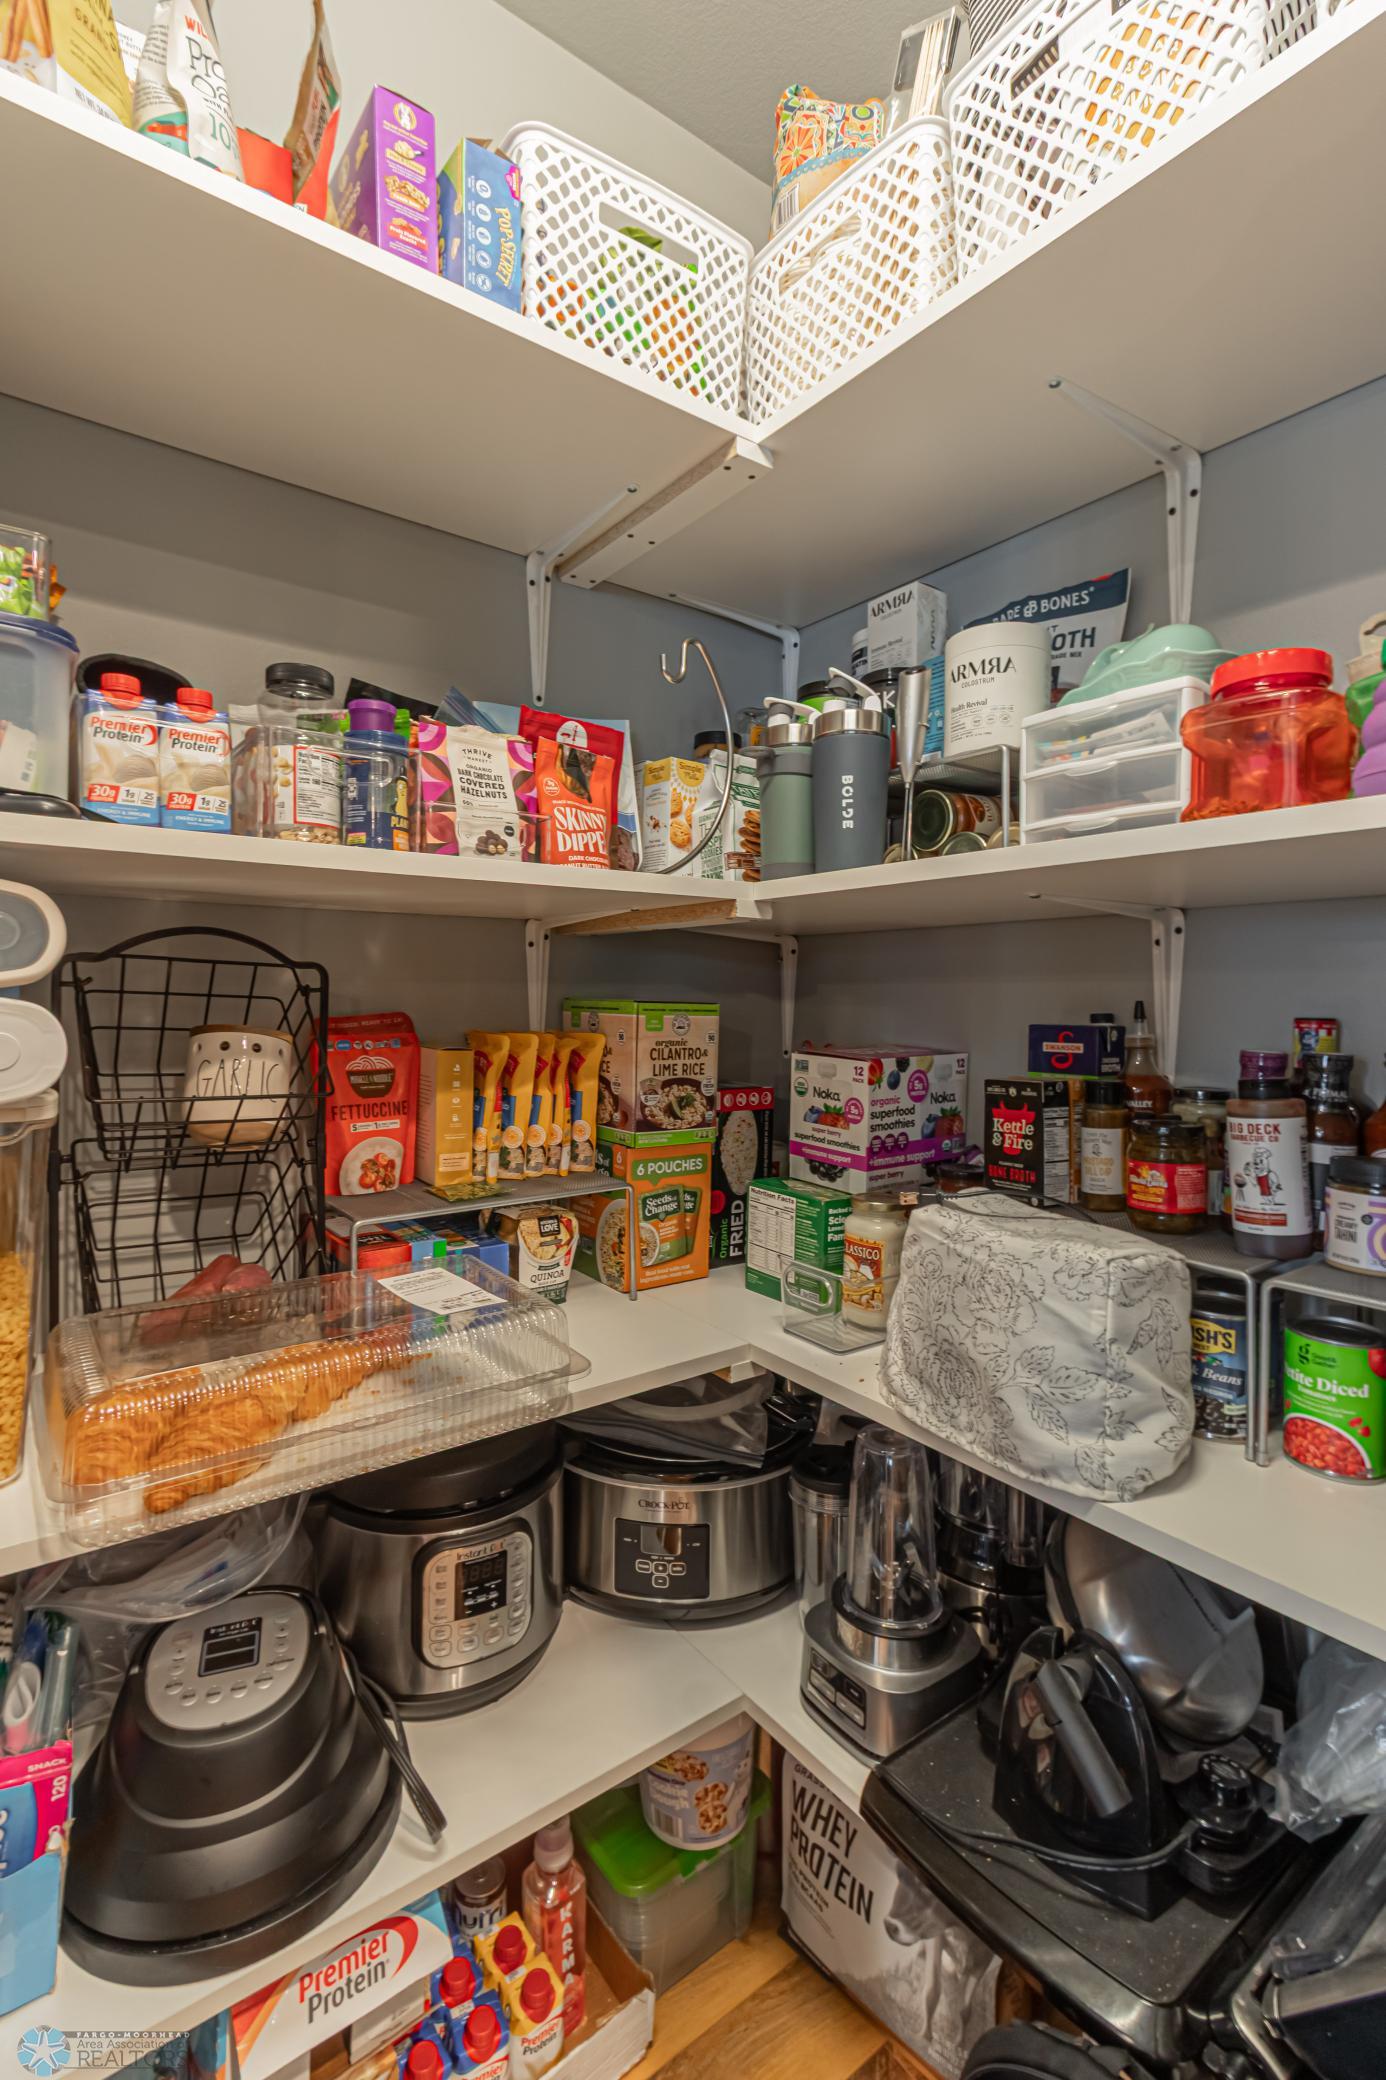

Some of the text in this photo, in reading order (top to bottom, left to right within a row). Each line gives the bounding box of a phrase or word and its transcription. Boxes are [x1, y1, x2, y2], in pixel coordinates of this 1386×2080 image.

[1040, 590, 1090, 613] BONES
[961, 676, 995, 689] COLOSTRUM
[966, 698, 988, 709] Revival
[90, 716, 147, 735] Premier
[93, 726, 142, 744] Protein
[168, 728, 222, 745] Premier
[171, 737, 218, 754] Protein
[462, 748, 493, 760] THRIVE
[457, 768, 504, 783] DARK CHOCOLATE
[465, 763, 493, 774] ORGANIC
[459, 776, 505, 790] COVERED
[460, 784, 508, 799] HAZELNUTS
[655, 1037, 689, 1048] organic
[650, 1047, 702, 1061] CILANTRO
[652, 1063, 705, 1077] LIME RICE
[854, 1065, 865, 1076] 12
[956, 1058, 966, 1068] 12
[196, 1058, 279, 1103] GARLIC
[813, 1086, 841, 1102] Noka
[870, 1096, 901, 1109] organic
[930, 1092, 956, 1105] Noka
[331, 1101, 409, 1121] FETTUCCINE
[870, 1105, 916, 1121] superfood
[870, 1118, 916, 1133] smoothies
[993, 1118, 1035, 1135] Kettle
[1247, 1123, 1281, 1135] DECK
[794, 1132, 861, 1152] superfood smoothies
[992, 1132, 1034, 1151] & Fire
[906, 1150, 936, 1163] support
[636, 1158, 703, 1176] 6 POUCHES
[886, 1170, 904, 1180] berry
[988, 1164, 1008, 1178] BONE
[1009, 1168, 1037, 1184] BROTH
[646, 1194, 672, 1207] Seeds
[750, 1187, 795, 1205] Nutrition Facts
[645, 1201, 678, 1217] Change
[729, 1200, 745, 1258] FRIED
[844, 1243, 880, 1261] LASSICO
[530, 1269, 565, 1284] QUINOA
[1202, 1367, 1243, 1386] Beans
[1317, 1377, 1369, 1398] Diced
[27, 1757, 67, 1773] SNACK
[51, 1774, 68, 1801] 120
[792, 1778, 858, 1859] WHEY
[790, 1821, 874, 1925] PROTEIN
[560, 1901, 577, 1986] KARMA
[299, 1931, 390, 2004] Premier
[308, 1959, 387, 2024] Protein
[520, 2022, 560, 2047] Premier
[522, 2031, 559, 2056] Protein
